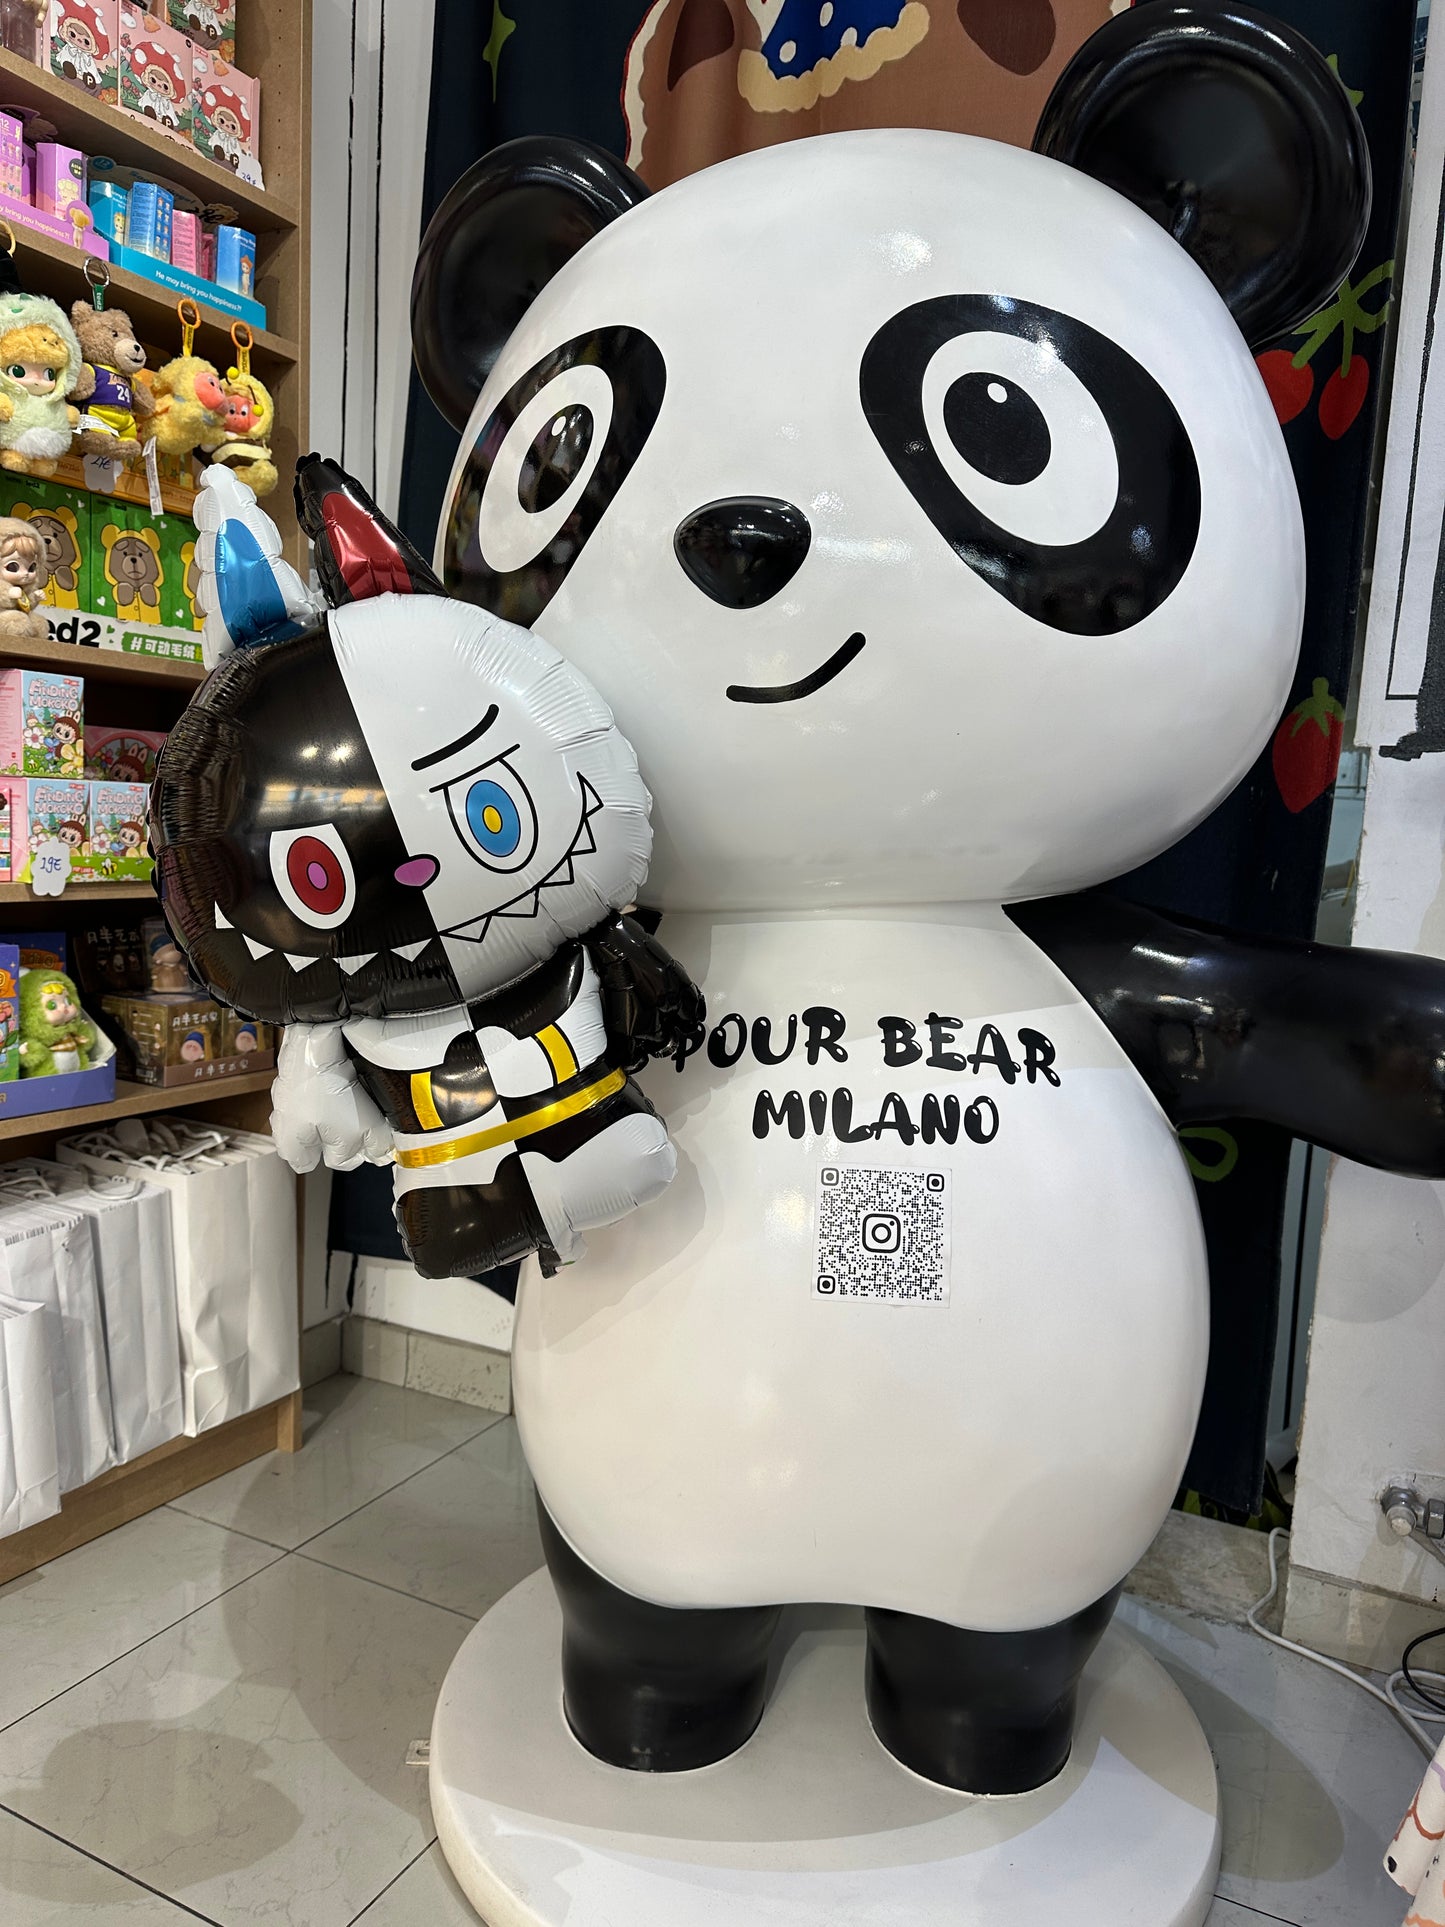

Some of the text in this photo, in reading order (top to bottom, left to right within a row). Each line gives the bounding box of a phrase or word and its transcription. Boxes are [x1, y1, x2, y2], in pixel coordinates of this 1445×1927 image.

[6, 206, 22, 218] bring
[22, 214, 34, 225] you
[155, 270, 165, 280] He
[166, 275, 180, 287] may
[180, 280, 197, 295] bring
[197, 288, 208, 299] you
[116, 384, 130, 404] 24
[29, 679, 79, 699] FINDING
[29, 696, 79, 711] MOKOKO
[34, 786, 84, 804] FINDING
[97, 788, 143, 804] FINDING
[35, 803, 84, 815] MOKOKO
[98, 804, 143, 816] MOKOKO
[673, 1006, 1062, 1088] POUR BEAR
[752, 1086, 1001, 1147] MILANO
